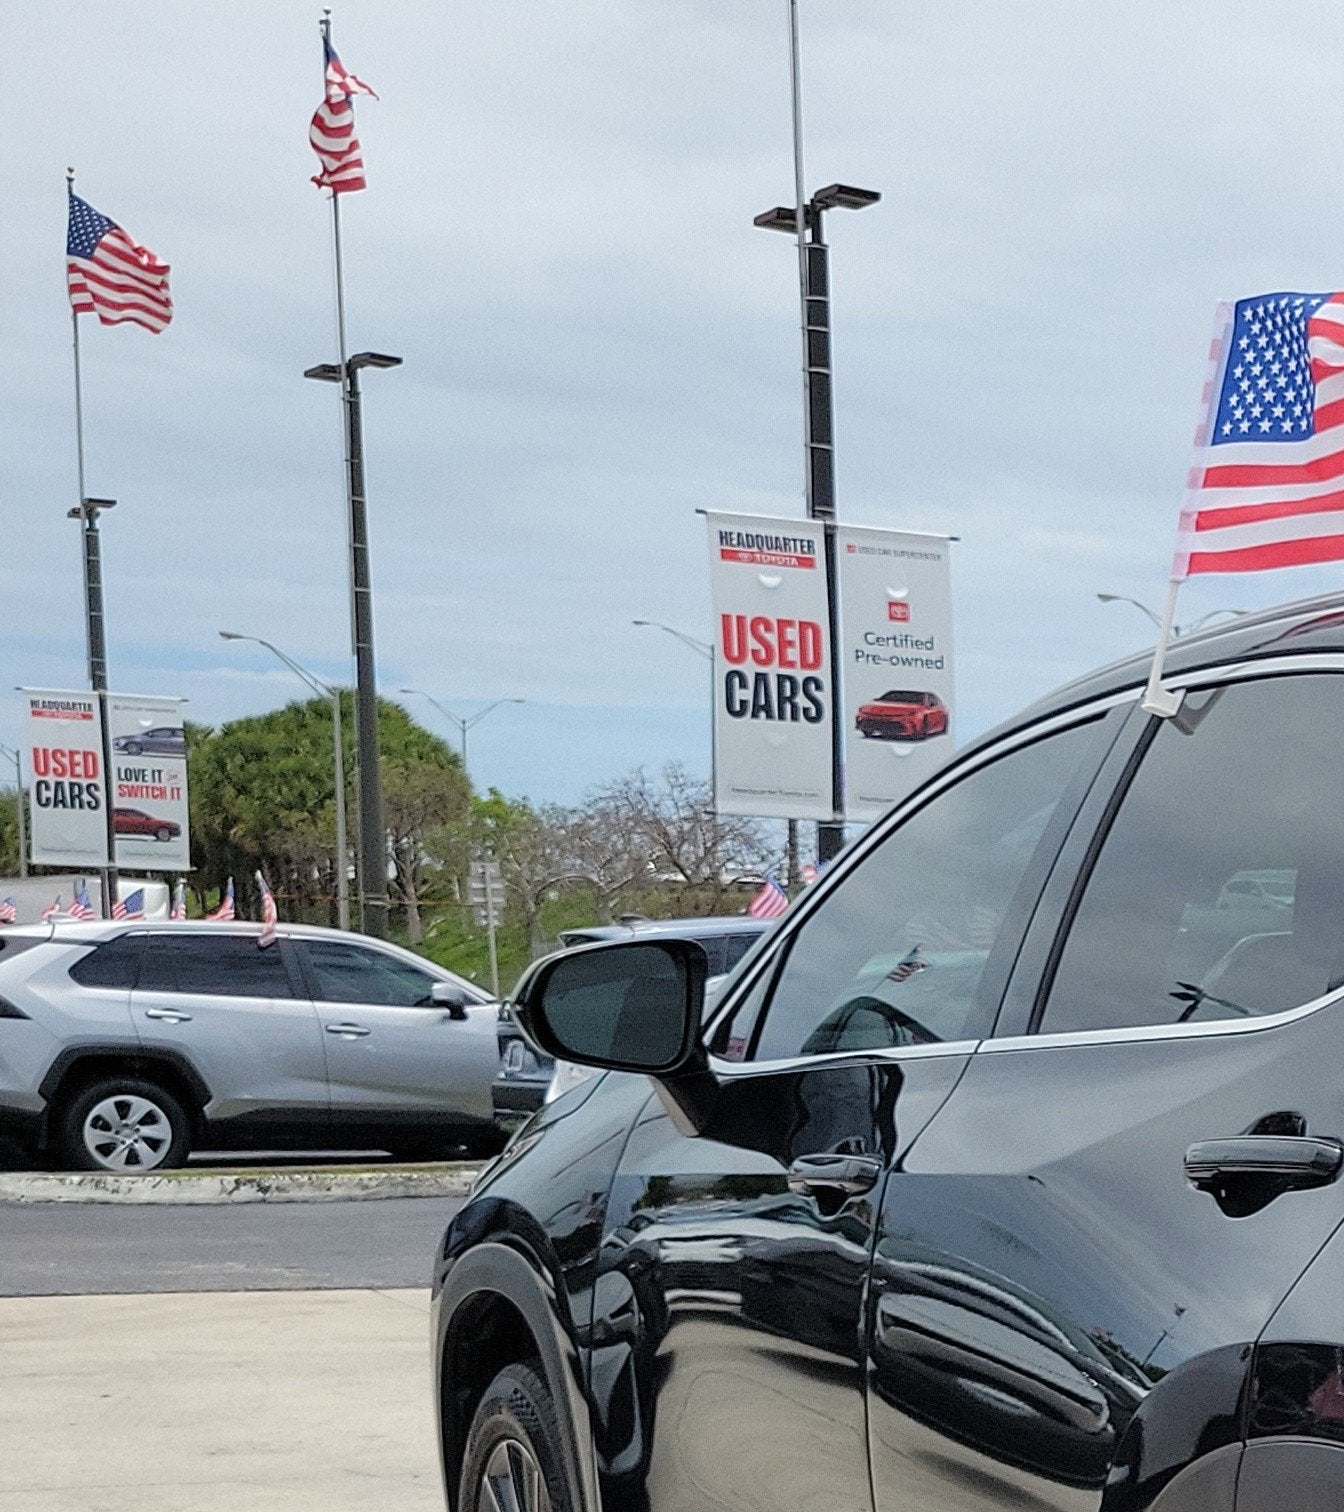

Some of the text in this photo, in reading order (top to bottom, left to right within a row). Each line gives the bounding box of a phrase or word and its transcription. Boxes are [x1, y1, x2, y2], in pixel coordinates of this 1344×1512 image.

[718, 530, 816, 555] HEADQUARTER
[720, 613, 824, 671] USED
[863, 632, 934, 651] Certified
[854, 648, 944, 670] Pre-owned
[724, 669, 825, 724] CARS
[32, 747, 99, 780] USED
[117, 766, 149, 783] LOVE
[151, 769, 163, 784] IT
[36, 779, 100, 811] CARS
[118, 783, 181, 801] SWITCH IT
